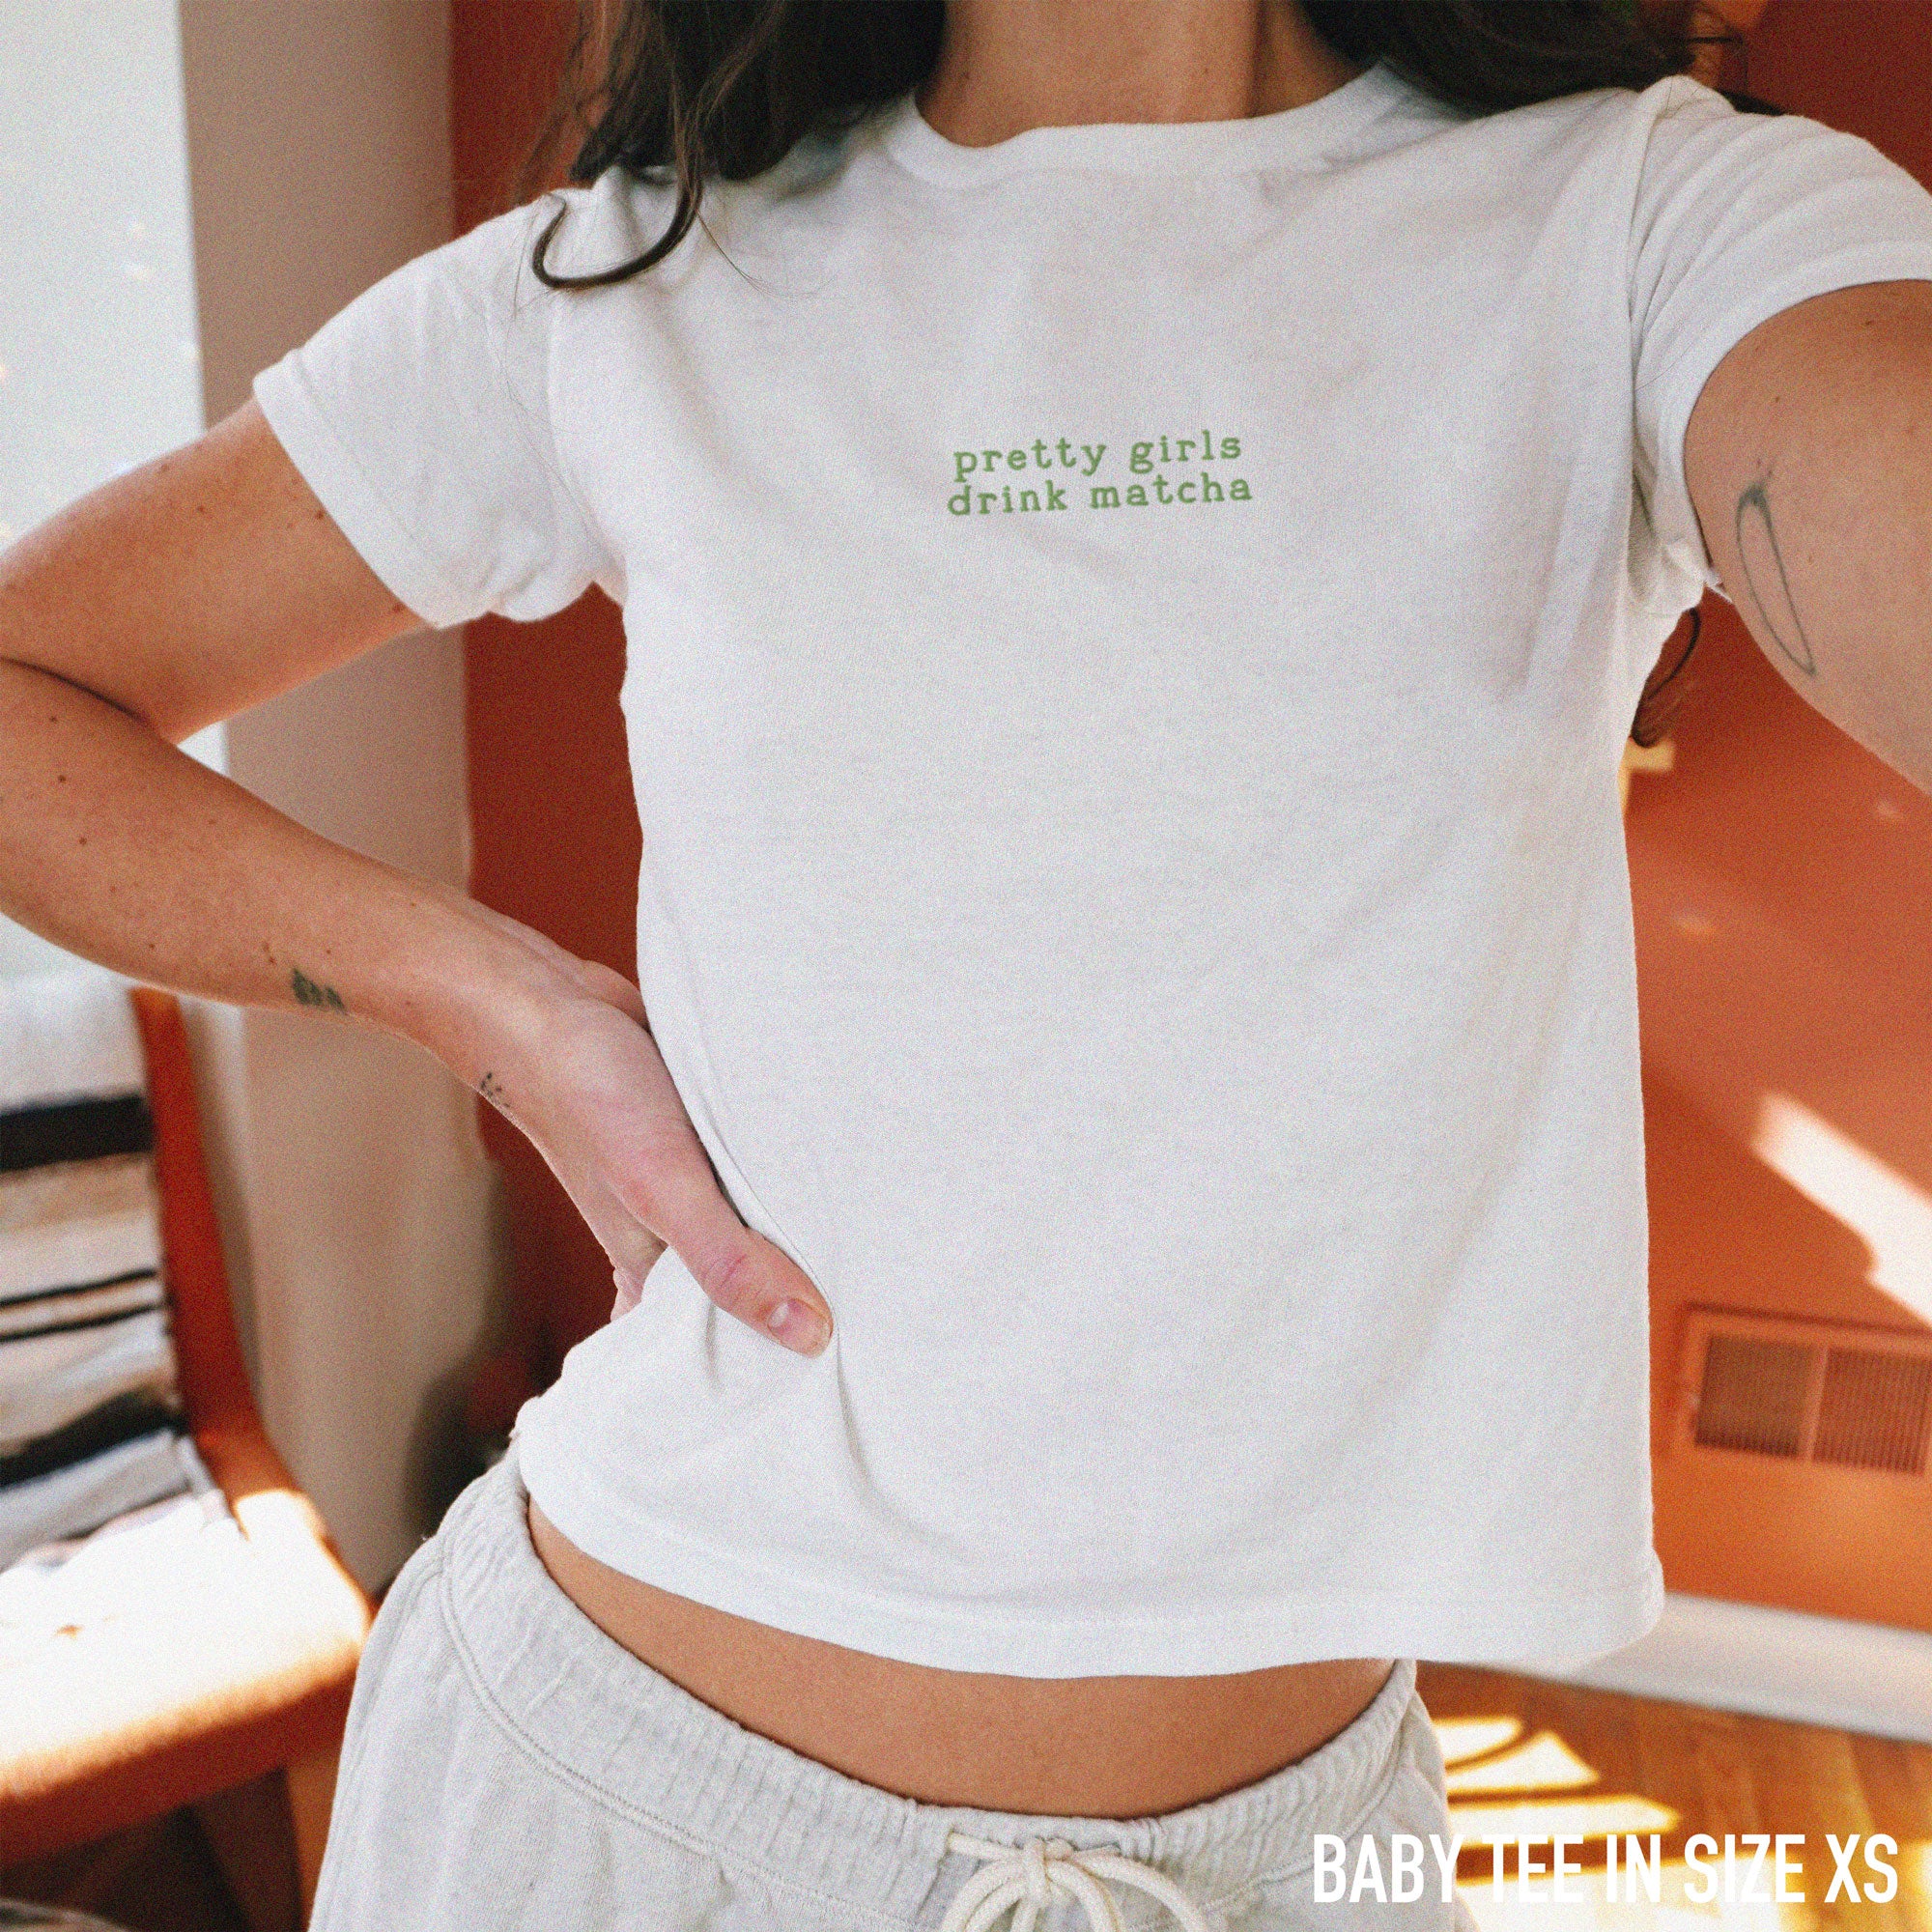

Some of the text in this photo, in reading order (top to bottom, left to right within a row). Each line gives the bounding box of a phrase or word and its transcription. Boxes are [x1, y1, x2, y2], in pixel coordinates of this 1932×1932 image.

[953, 429, 1241, 483] pretty girls
[947, 471, 1253, 516] drink matcha
